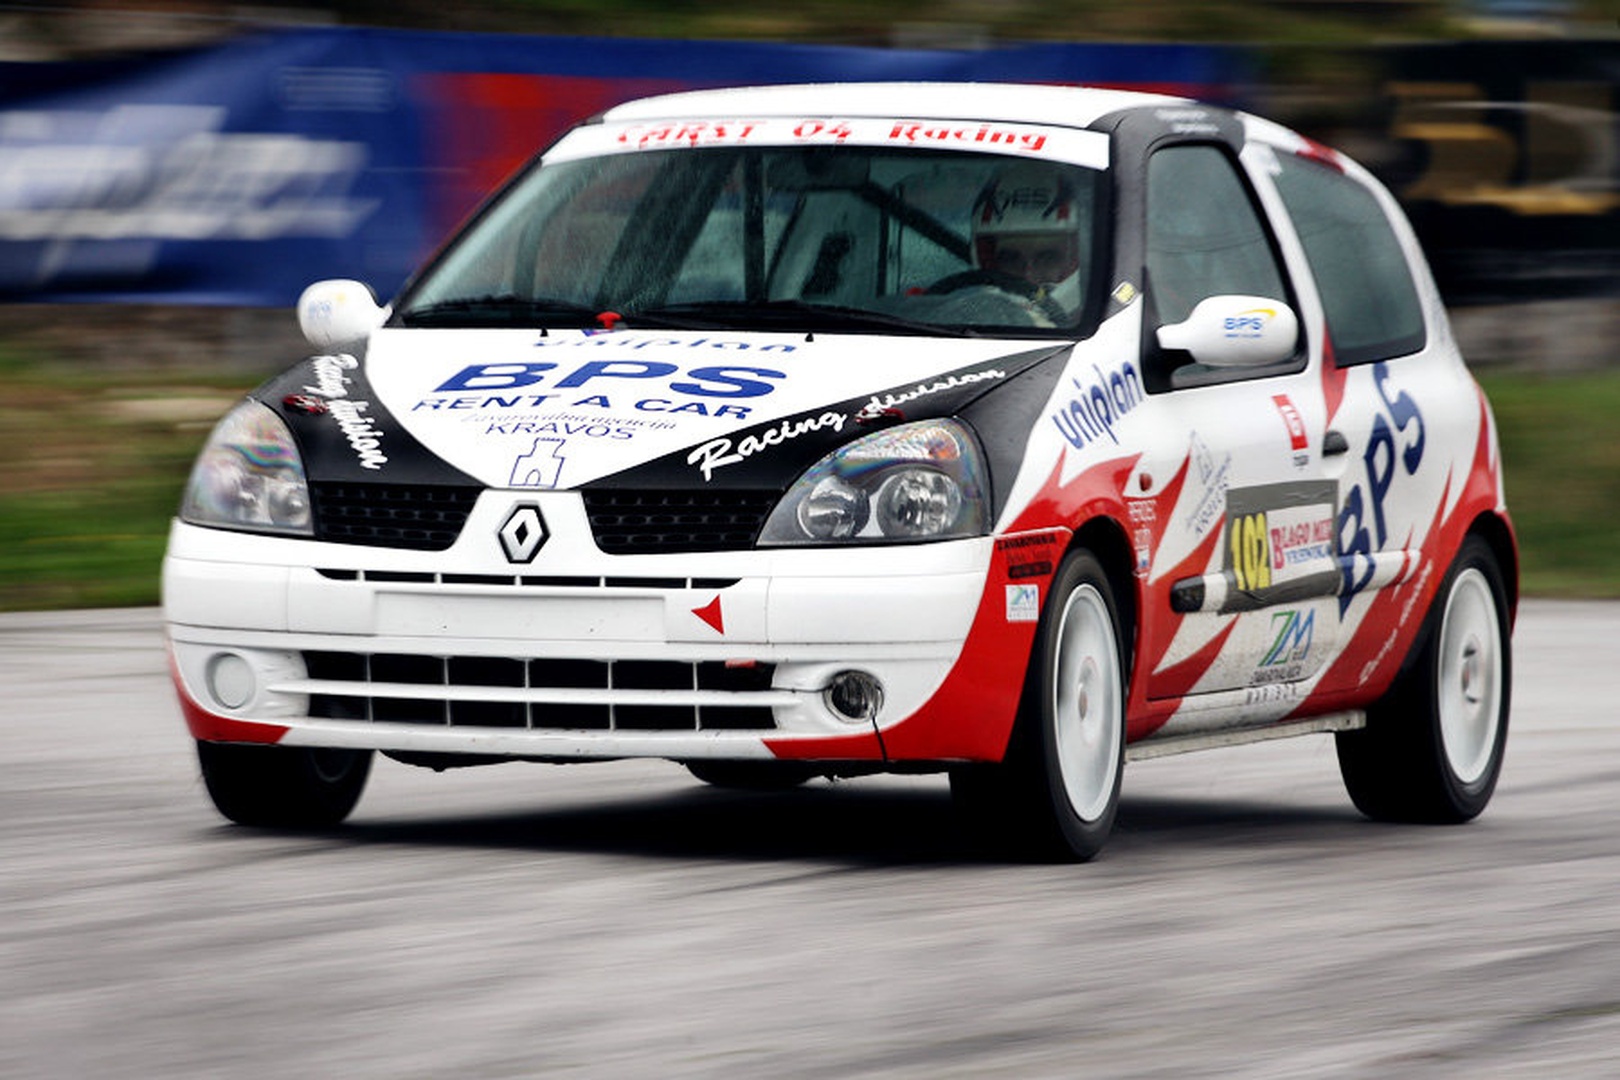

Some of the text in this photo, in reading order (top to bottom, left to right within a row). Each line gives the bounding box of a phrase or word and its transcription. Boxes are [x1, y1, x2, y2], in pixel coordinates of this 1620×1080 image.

[889, 122, 1049, 152] Racing
[1224, 318, 1263, 331] BPS
[432, 360, 788, 399] BPS
[411, 394, 754, 420] RENT A CAR
[686, 367, 1006, 483] Racing division
[1052, 361, 1144, 450] uniplan
[485, 421, 638, 441] KRAVOS
[1337, 360, 1426, 625] BPS
[1230, 512, 1271, 591] 102
[1257, 607, 1316, 668] ZM
